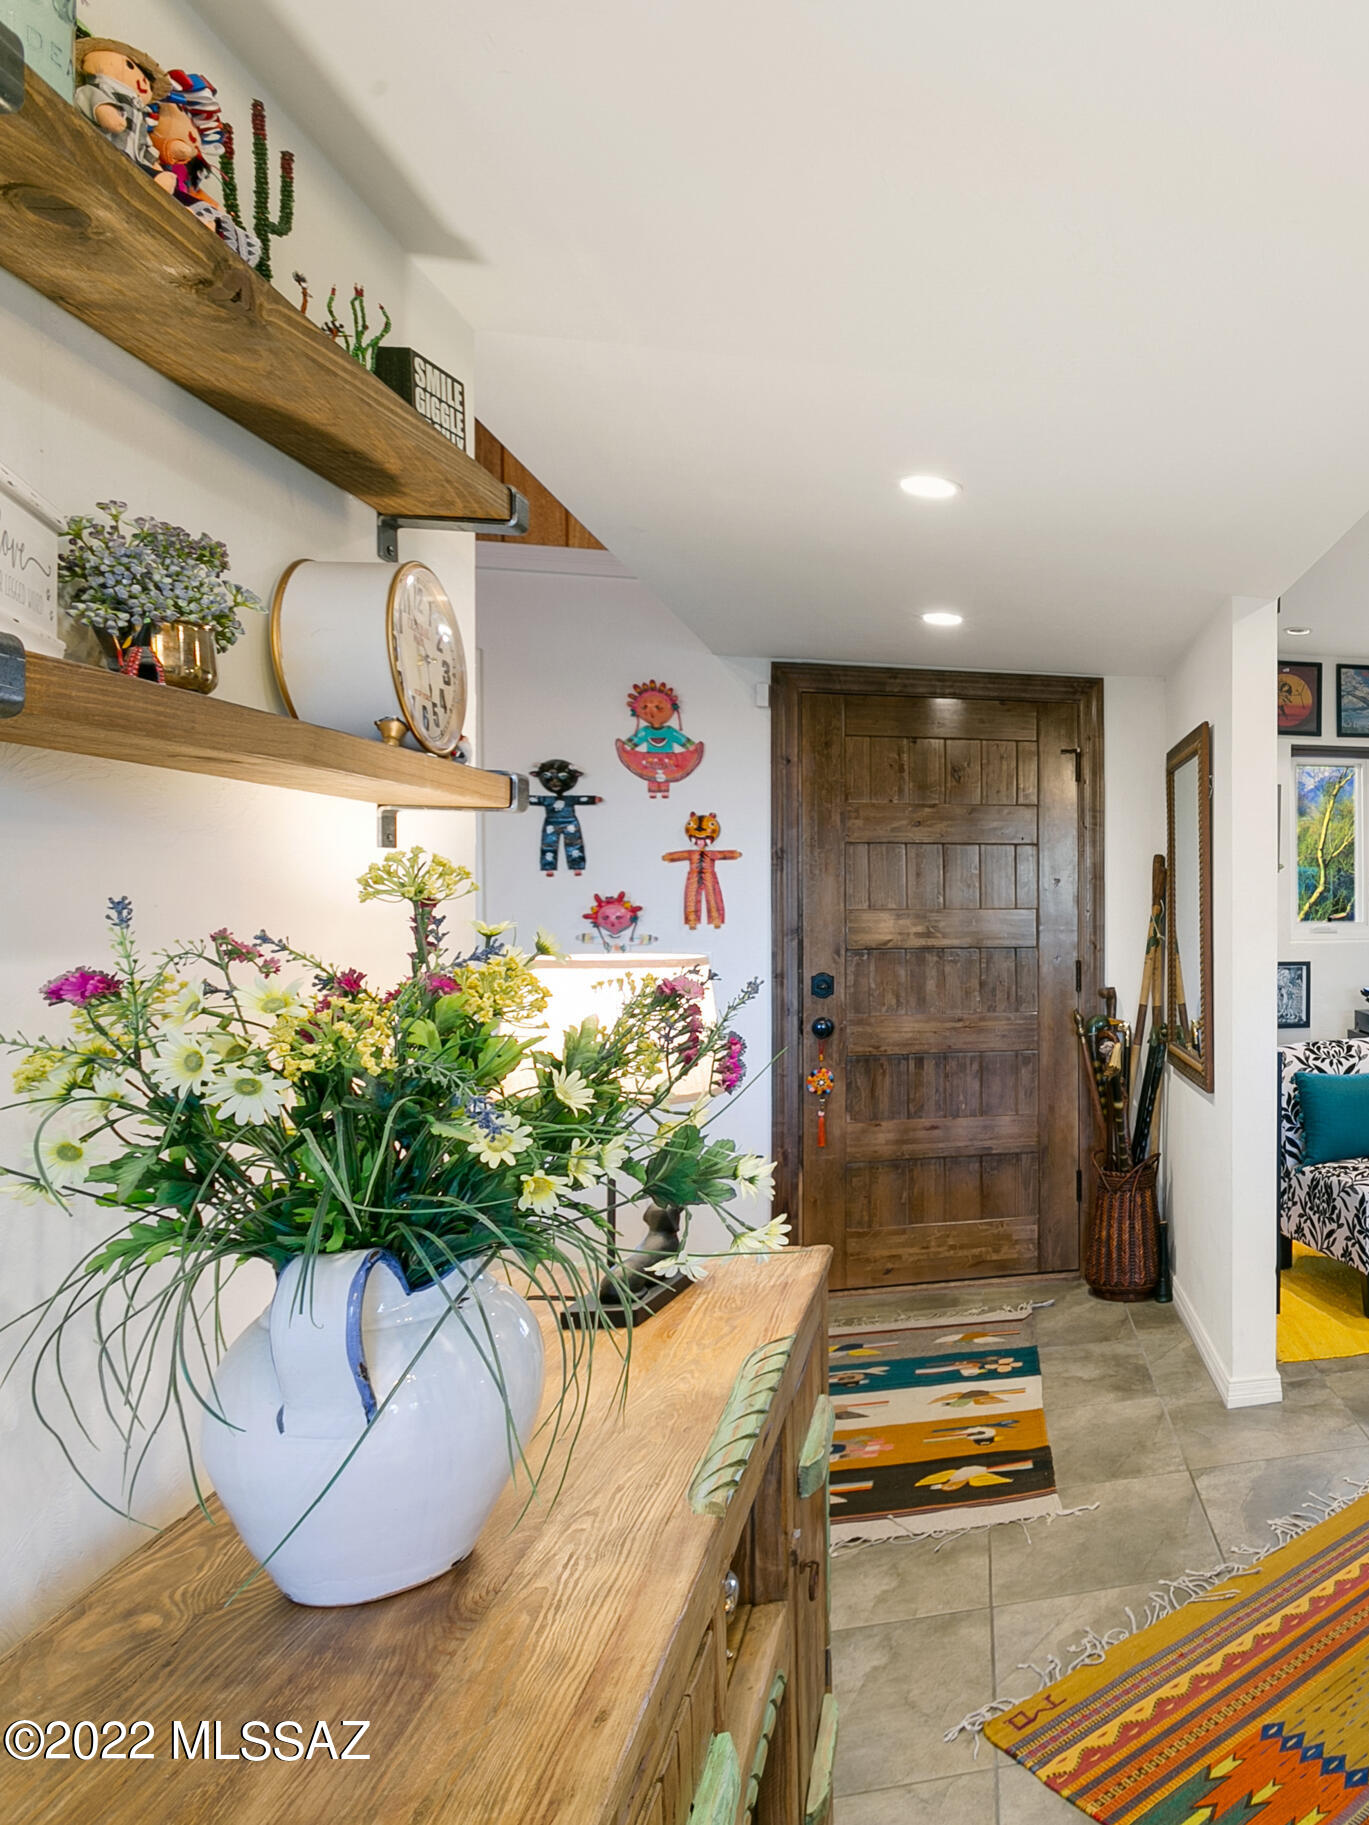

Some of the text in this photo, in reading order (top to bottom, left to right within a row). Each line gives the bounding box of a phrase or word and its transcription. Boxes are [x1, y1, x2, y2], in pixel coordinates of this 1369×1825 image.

[413, 356, 463, 411] SMILE
[414, 386, 465, 440] GIGGLE
[439, 688, 448, 714] 4
